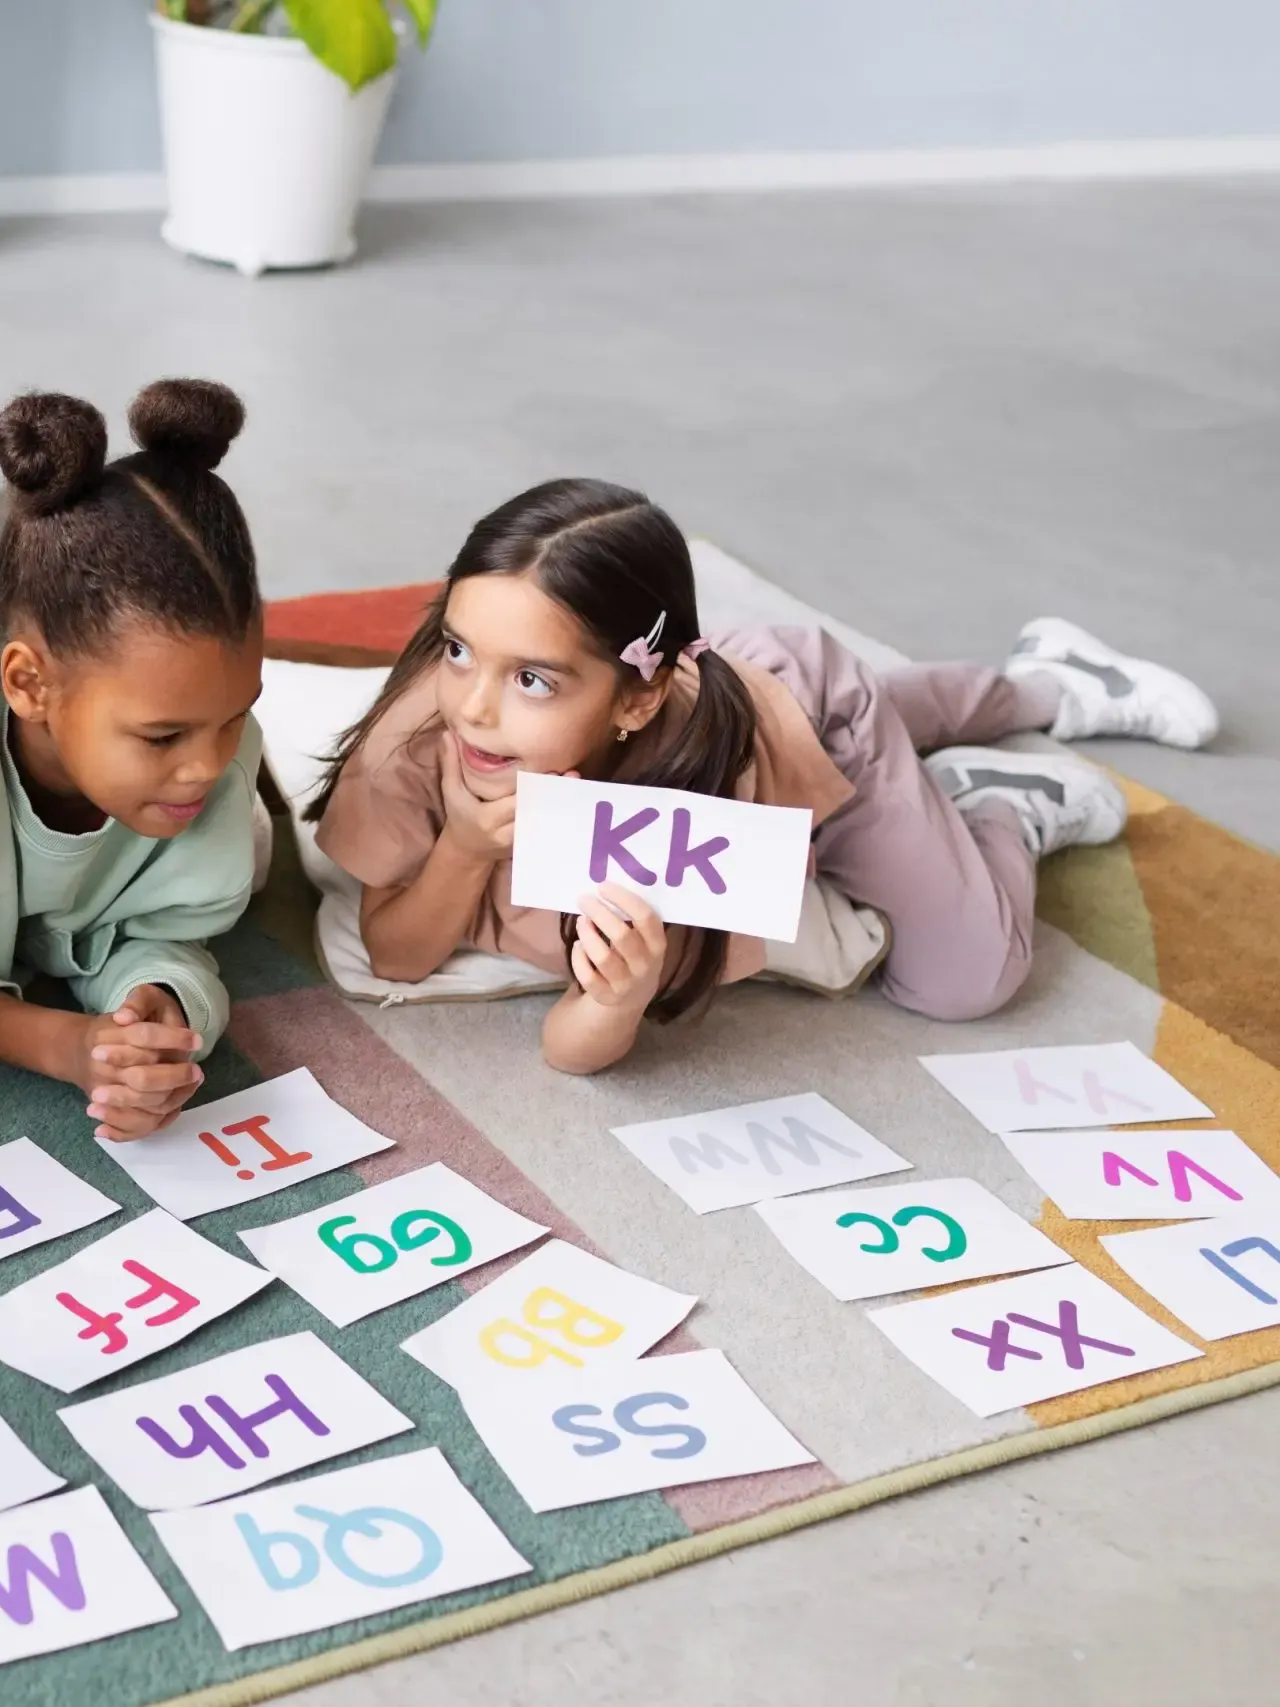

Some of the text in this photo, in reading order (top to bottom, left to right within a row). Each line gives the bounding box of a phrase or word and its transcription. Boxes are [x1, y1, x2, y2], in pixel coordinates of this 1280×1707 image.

[589, 801, 730, 895] Kk
[198, 1115, 312, 1181] Ii
[668, 1116, 862, 1177] Ww
[1102, 1150, 1244, 1202] Vv
[319, 1209, 473, 1275] Gg
[836, 1206, 967, 1263] Cc
[55, 1259, 201, 1355] Ff
[478, 1285, 626, 1370] Bb
[951, 1300, 1136, 1372] Xx
[135, 1373, 331, 1470] Hh
[552, 1392, 706, 1459] Ss
[234, 1505, 444, 1589] Qq
